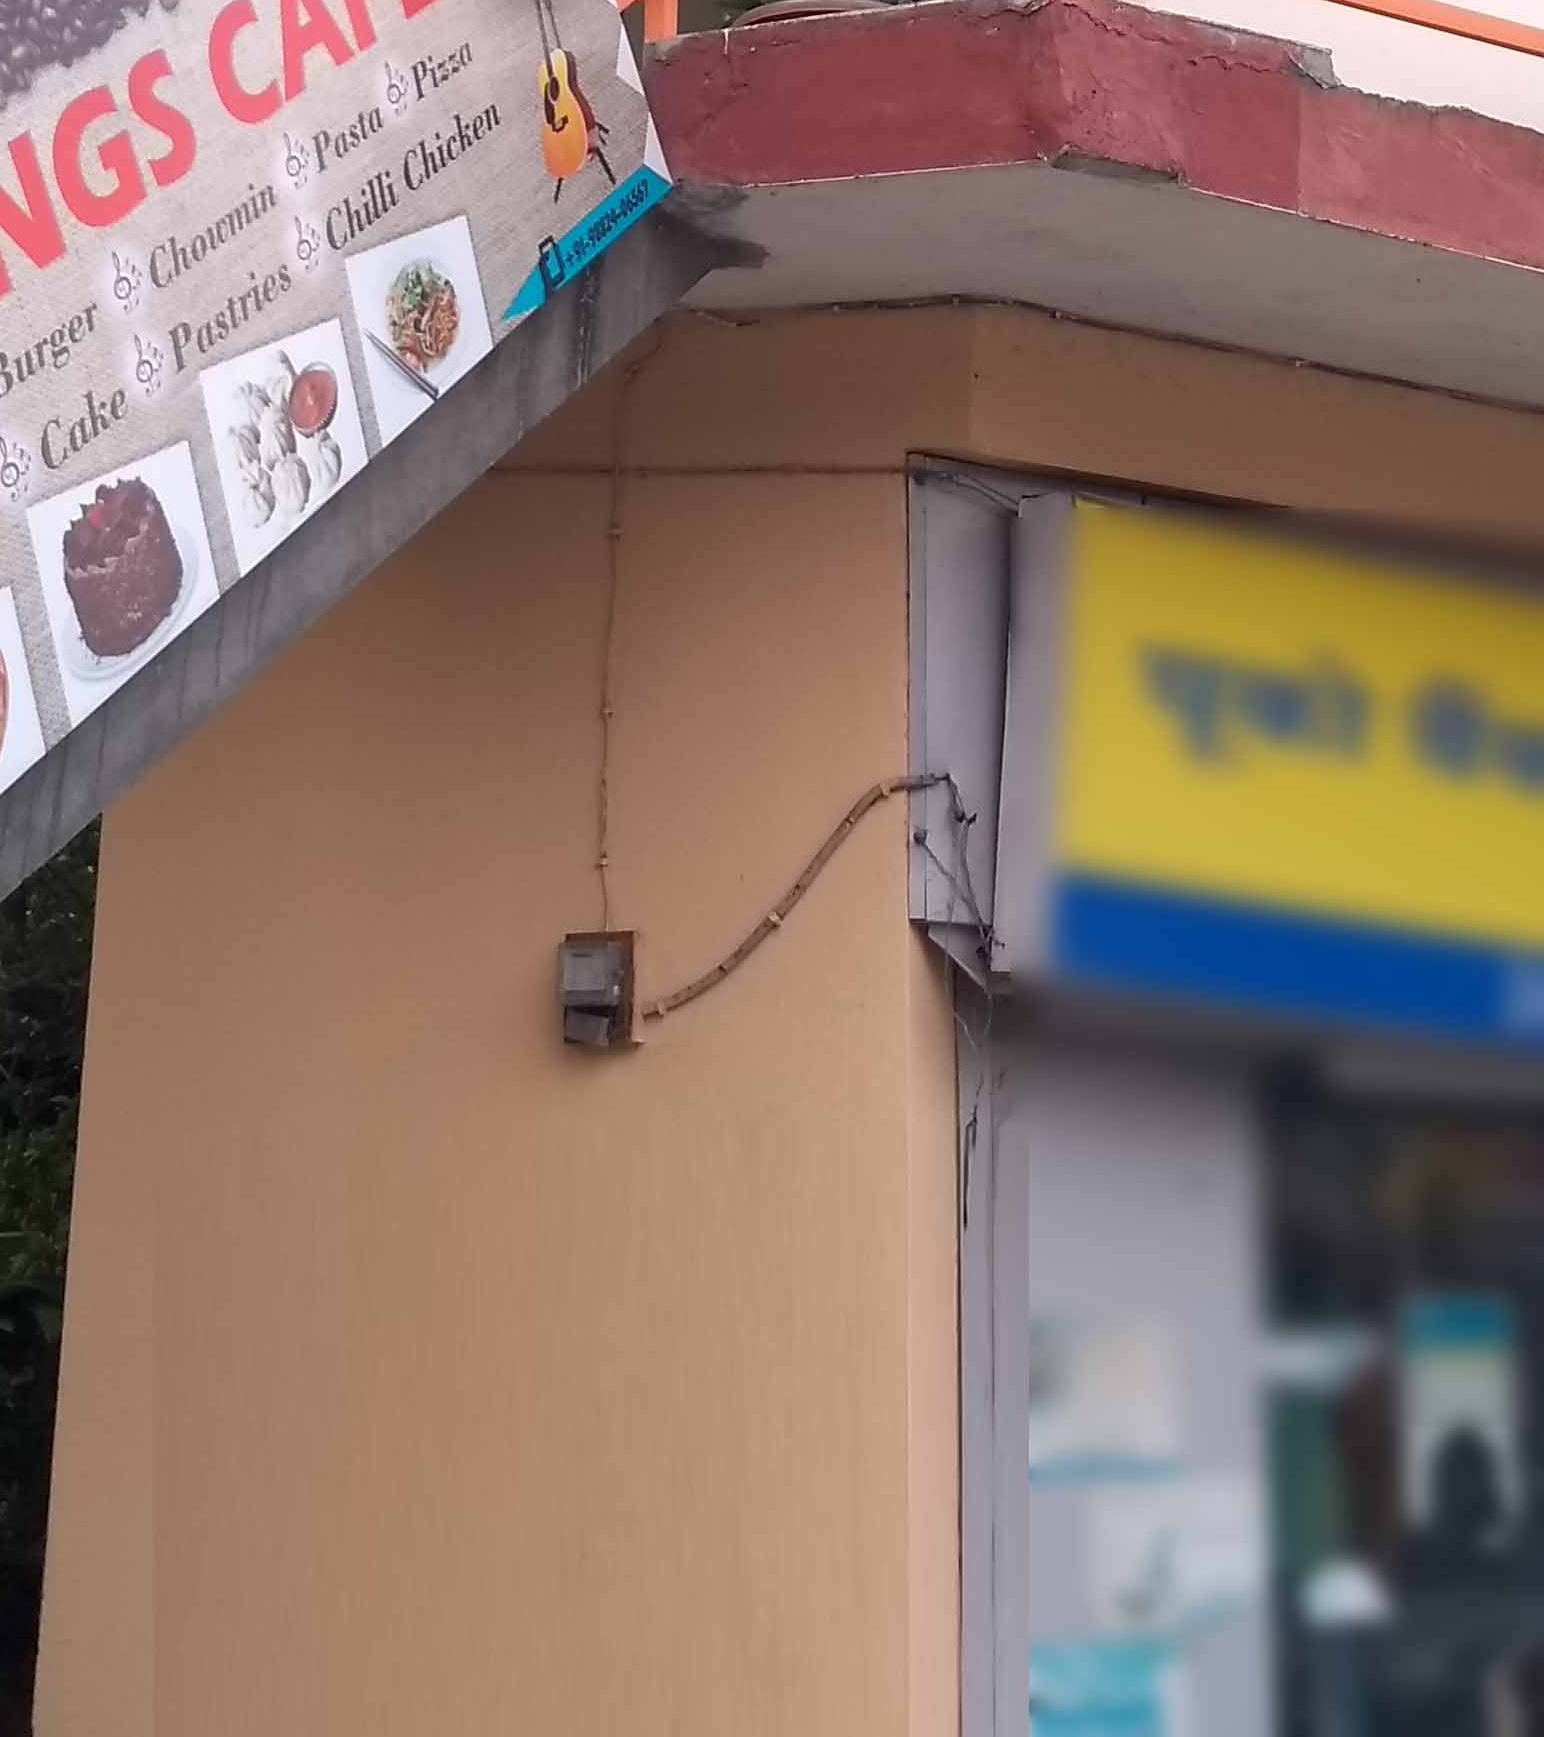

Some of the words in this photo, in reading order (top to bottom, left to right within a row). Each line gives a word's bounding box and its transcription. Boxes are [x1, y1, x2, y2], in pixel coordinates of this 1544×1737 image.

[40, 387, 128, 471] Cake
[168, 261, 292, 373] Pastries
[326, 170, 399, 251] Chilli
[403, 101, 501, 193] Chicken
[150, 182, 277, 290] Chowmin
[312, 109, 383, 173] Pasta
[409, 41, 473, 101] Pizza
